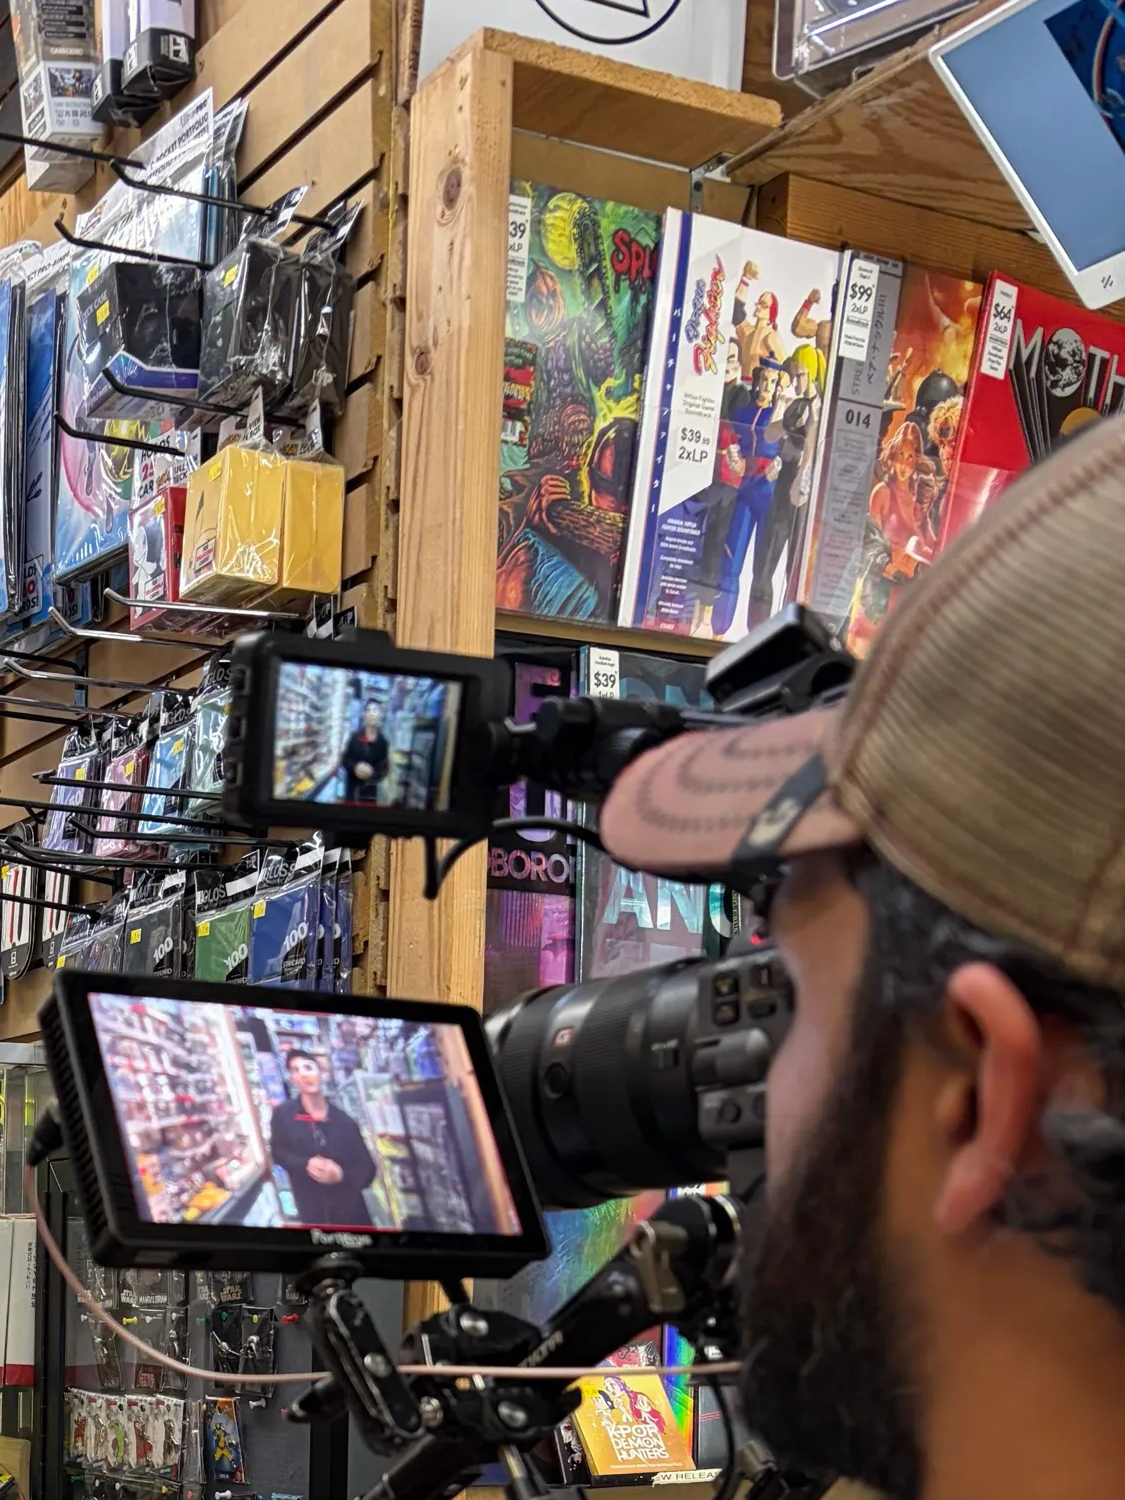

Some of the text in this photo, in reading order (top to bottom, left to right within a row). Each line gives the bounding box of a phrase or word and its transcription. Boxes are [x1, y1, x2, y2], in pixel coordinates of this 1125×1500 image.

[850, 283, 873, 302] $99
[993, 302, 1012, 322] $64
[845, 408, 871, 429] 014
[678, 446, 709, 464] 2xLP
[594, 671, 617, 688] $39
[488, 848, 575, 885] BORO
[283, 922, 309, 951] 100
[153, 936, 173, 964] 100
[220, 1292, 242, 1300] WARS
[612, 1437, 665, 1451] DEMON
[616, 1449, 669, 1465] HUNTERS
